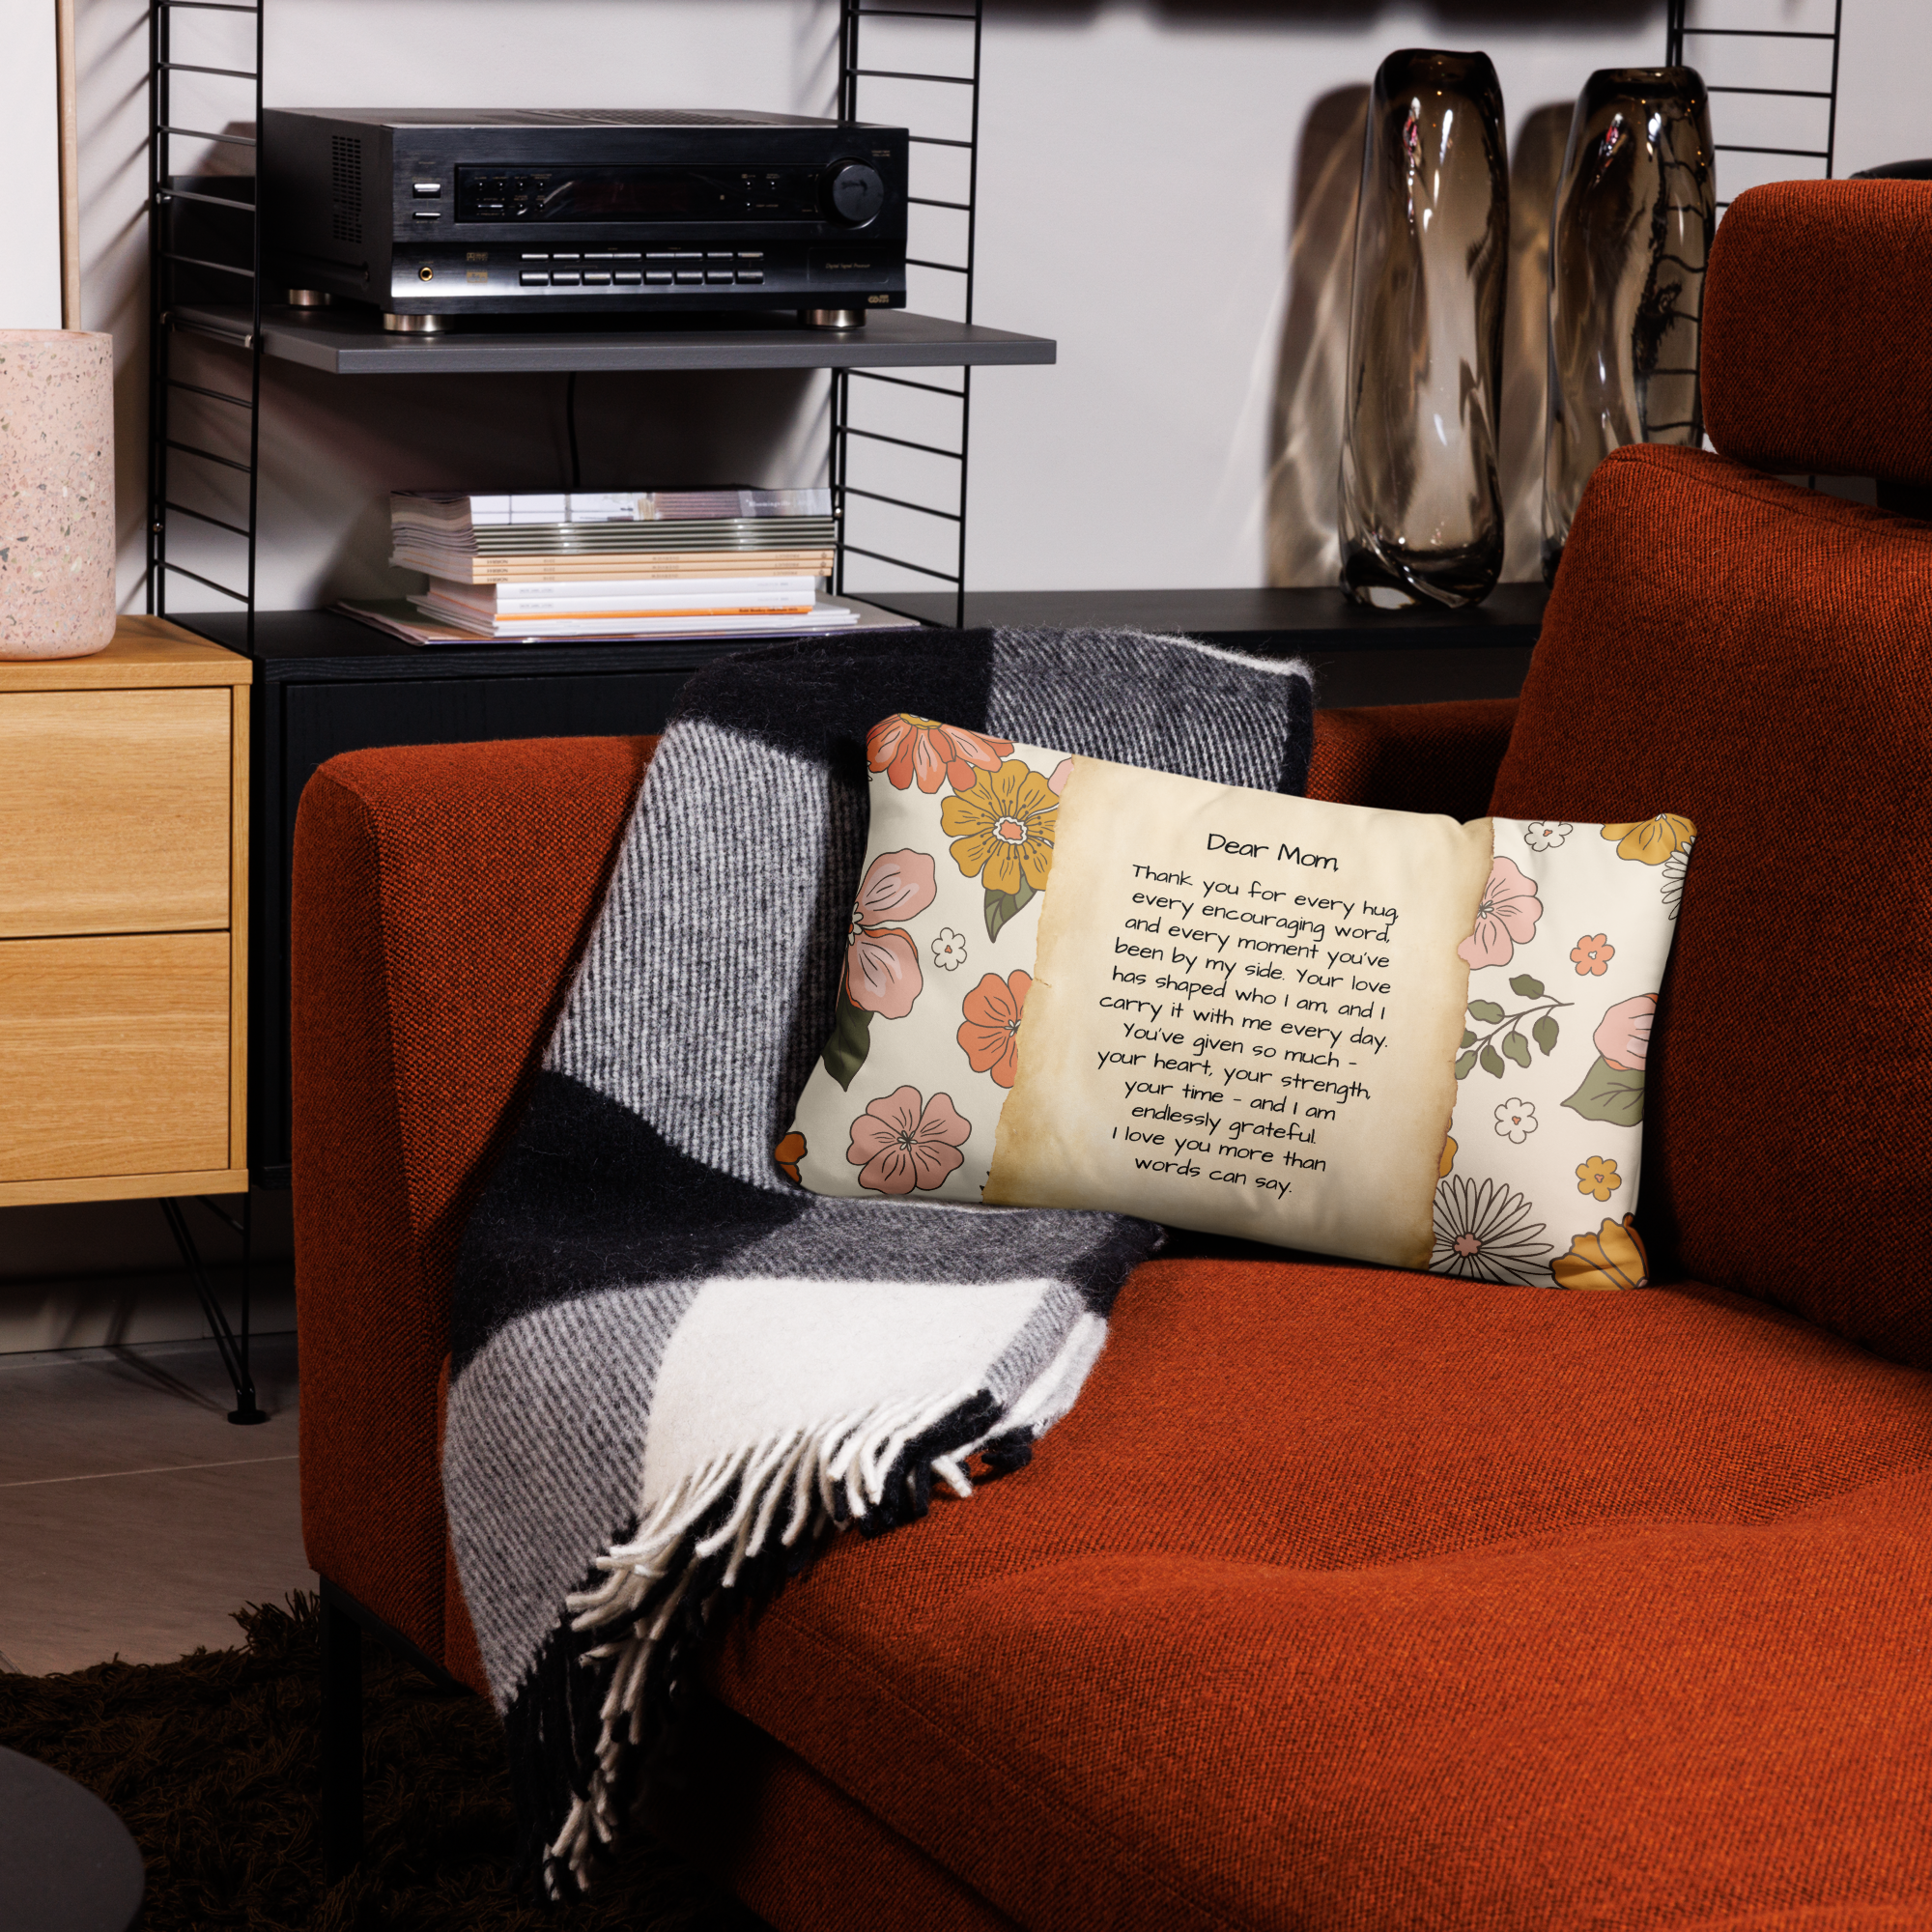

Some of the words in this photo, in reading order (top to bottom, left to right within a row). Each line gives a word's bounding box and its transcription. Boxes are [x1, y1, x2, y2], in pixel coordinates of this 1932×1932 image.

[1207, 833, 1269, 859] Dear
[1277, 842, 1339, 873] Mom,
[1131, 892, 1195, 921] every
[1202, 905, 1325, 943] encouraging
[1334, 923, 1391, 944] word,
[1132, 864, 1193, 887] Thank
[1203, 880, 1239, 898] you
[1247, 880, 1287, 902] for
[1293, 895, 1355, 921] every
[1362, 899, 1400, 925] hug,
[1114, 936, 1164, 961] been
[1171, 946, 1198, 975] by
[1205, 957, 1237, 980] my
[1244, 960, 1286, 980] side.
[1295, 968, 1345, 988] Your
[1351, 975, 1391, 994] love
[1124, 916, 1162, 934] and
[1168, 925, 1231, 953] every
[1236, 937, 1320, 959] moment
[1326, 951, 1390, 970] you've
[1112, 964, 1147, 985] has
[1154, 974, 1228, 1001] shaped
[1235, 987, 1277, 1006] who
[1284, 993, 1290, 1008] I
[1295, 999, 1328, 1014] am,
[1337, 1001, 1375, 1019] and
[1380, 1006, 1386, 1020] I
[1098, 996, 1163, 1023] carry
[1170, 1002, 1184, 1018] it
[1192, 1008, 1235, 1027] with
[1241, 1016, 1272, 1032] me
[1280, 1022, 1343, 1049] every
[1350, 1026, 1388, 1055] day.
[1122, 1022, 1185, 1045] You've
[1192, 1034, 1244, 1057] given
[1252, 1045, 1277, 1059] so
[1284, 1049, 1340, 1068] much
[1097, 1050, 1147, 1070] your
[1153, 1052, 1213, 1077] heart,
[1223, 1067, 1273, 1087] your
[1280, 1072, 1372, 1105] strength,
[1124, 1080, 1174, 1099] your
[1181, 1083, 1224, 1103] time
[1249, 1094, 1288, 1114] and
[1293, 1101, 1298, 1116] I
[1305, 1106, 1336, 1122] am
[1112, 1126, 1118, 1140] I
[1124, 1125, 1166, 1146] love
[1174, 1138, 1211, 1157] you
[1218, 1144, 1274, 1163] more
[1282, 1151, 1326, 1173] than
[1131, 1103, 1222, 1136] endlessly
[1228, 1121, 1317, 1145] grateful.
[1134, 1157, 1201, 1178] words
[1208, 1170, 1247, 1185] can
[1254, 1177, 1293, 1200] say.
